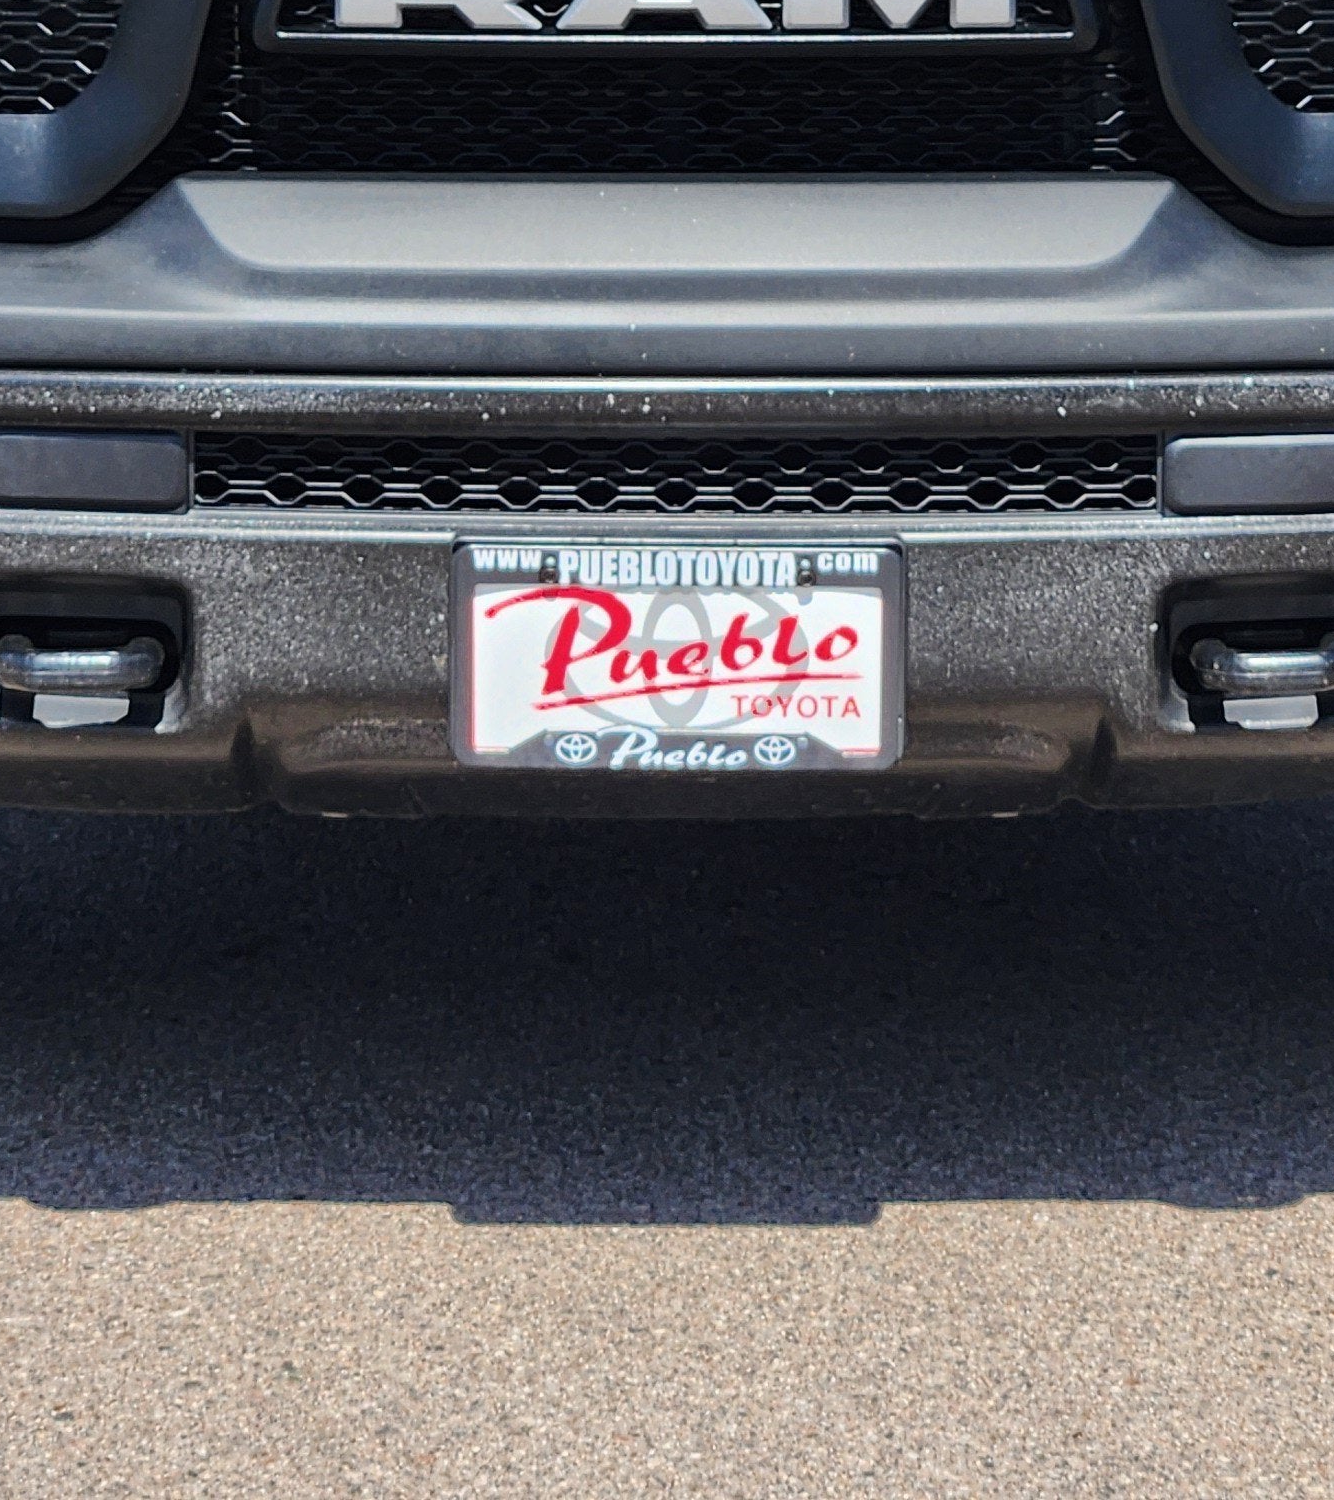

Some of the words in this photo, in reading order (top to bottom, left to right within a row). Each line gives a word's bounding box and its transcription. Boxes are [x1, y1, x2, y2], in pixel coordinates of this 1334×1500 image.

[485, 586, 859, 696] Pueblo
[732, 695, 862, 719] TOYOTA
[597, 725, 748, 770] Pueblo
